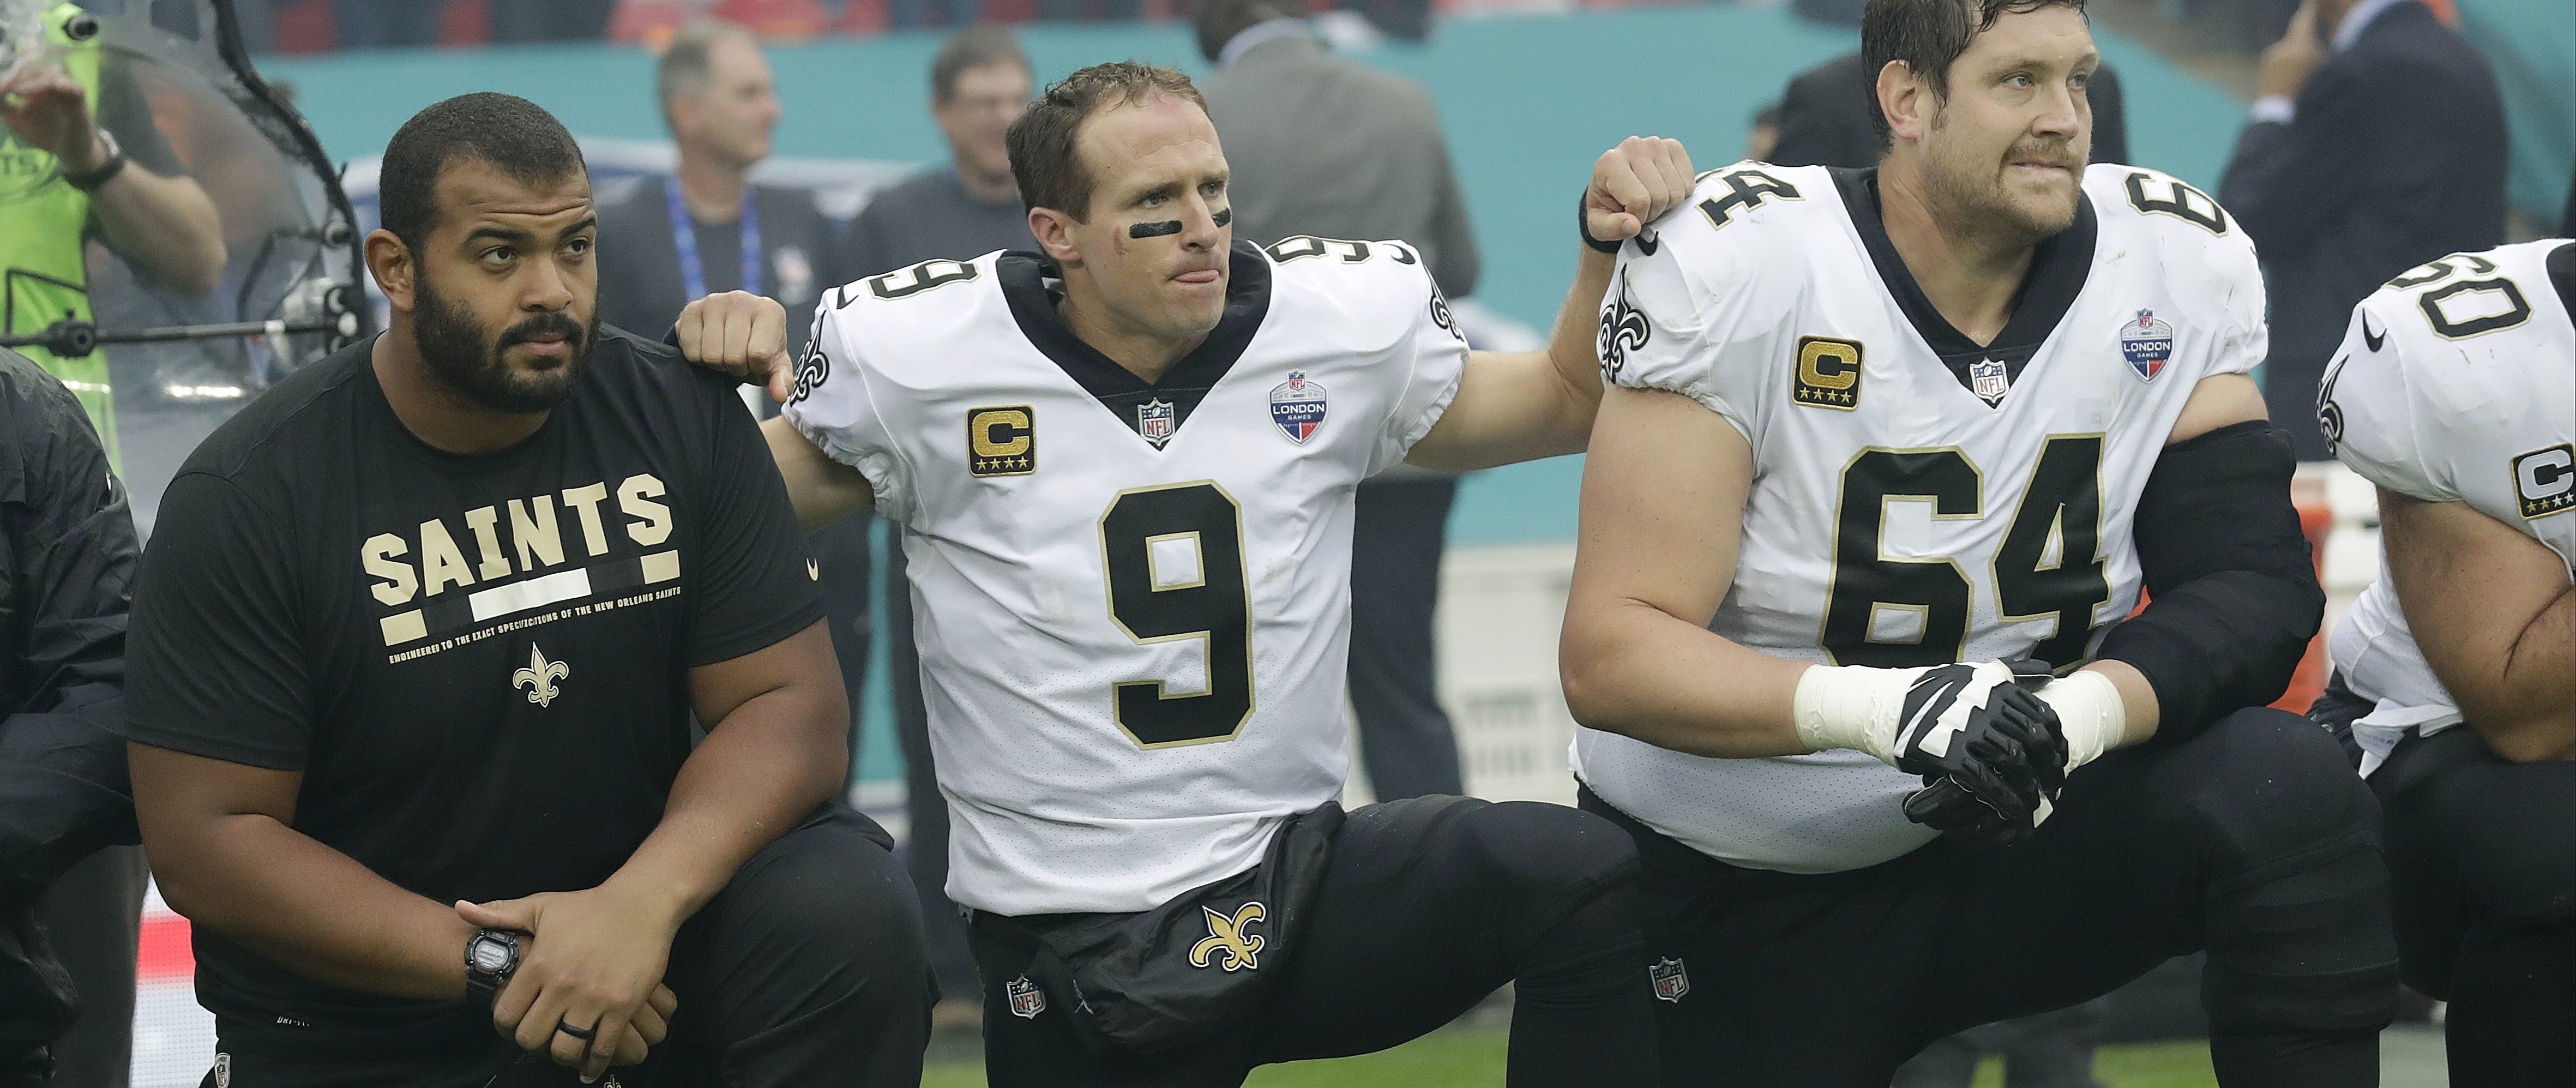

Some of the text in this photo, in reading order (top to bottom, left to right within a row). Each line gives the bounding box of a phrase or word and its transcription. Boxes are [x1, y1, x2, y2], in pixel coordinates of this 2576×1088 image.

[1695, 159, 1805, 231] 4
[2139, 317, 2152, 326] NFL
[2123, 341, 2170, 352] LONDON
[1799, 340, 1857, 390] C
[1291, 379, 1304, 389] NFL
[1978, 377, 2002, 393] NFL
[1273, 403, 1325, 414] LONDON
[972, 410, 1030, 457] C
[1146, 419, 1170, 436] NFL
[2518, 449, 2574, 500] C
[360, 473, 673, 606] SAINTS
[1817, 431, 2113, 676] 64
[389, 644, 440, 664] ENGINEERED
[441, 640, 453, 650] TO
[455, 634, 470, 646] THE
[472, 627, 496, 641] EXACT
[561, 609, 572, 618] OF
[575, 605, 592, 616] THE
[594, 600, 614, 612] NEW
[617, 593, 654, 608] ORLEANS
[655, 586, 681, 600] SAINTS
[1097, 478, 1256, 750] 9
[1016, 993, 1040, 1011] NFL
[1660, 978, 1683, 994] NFL
